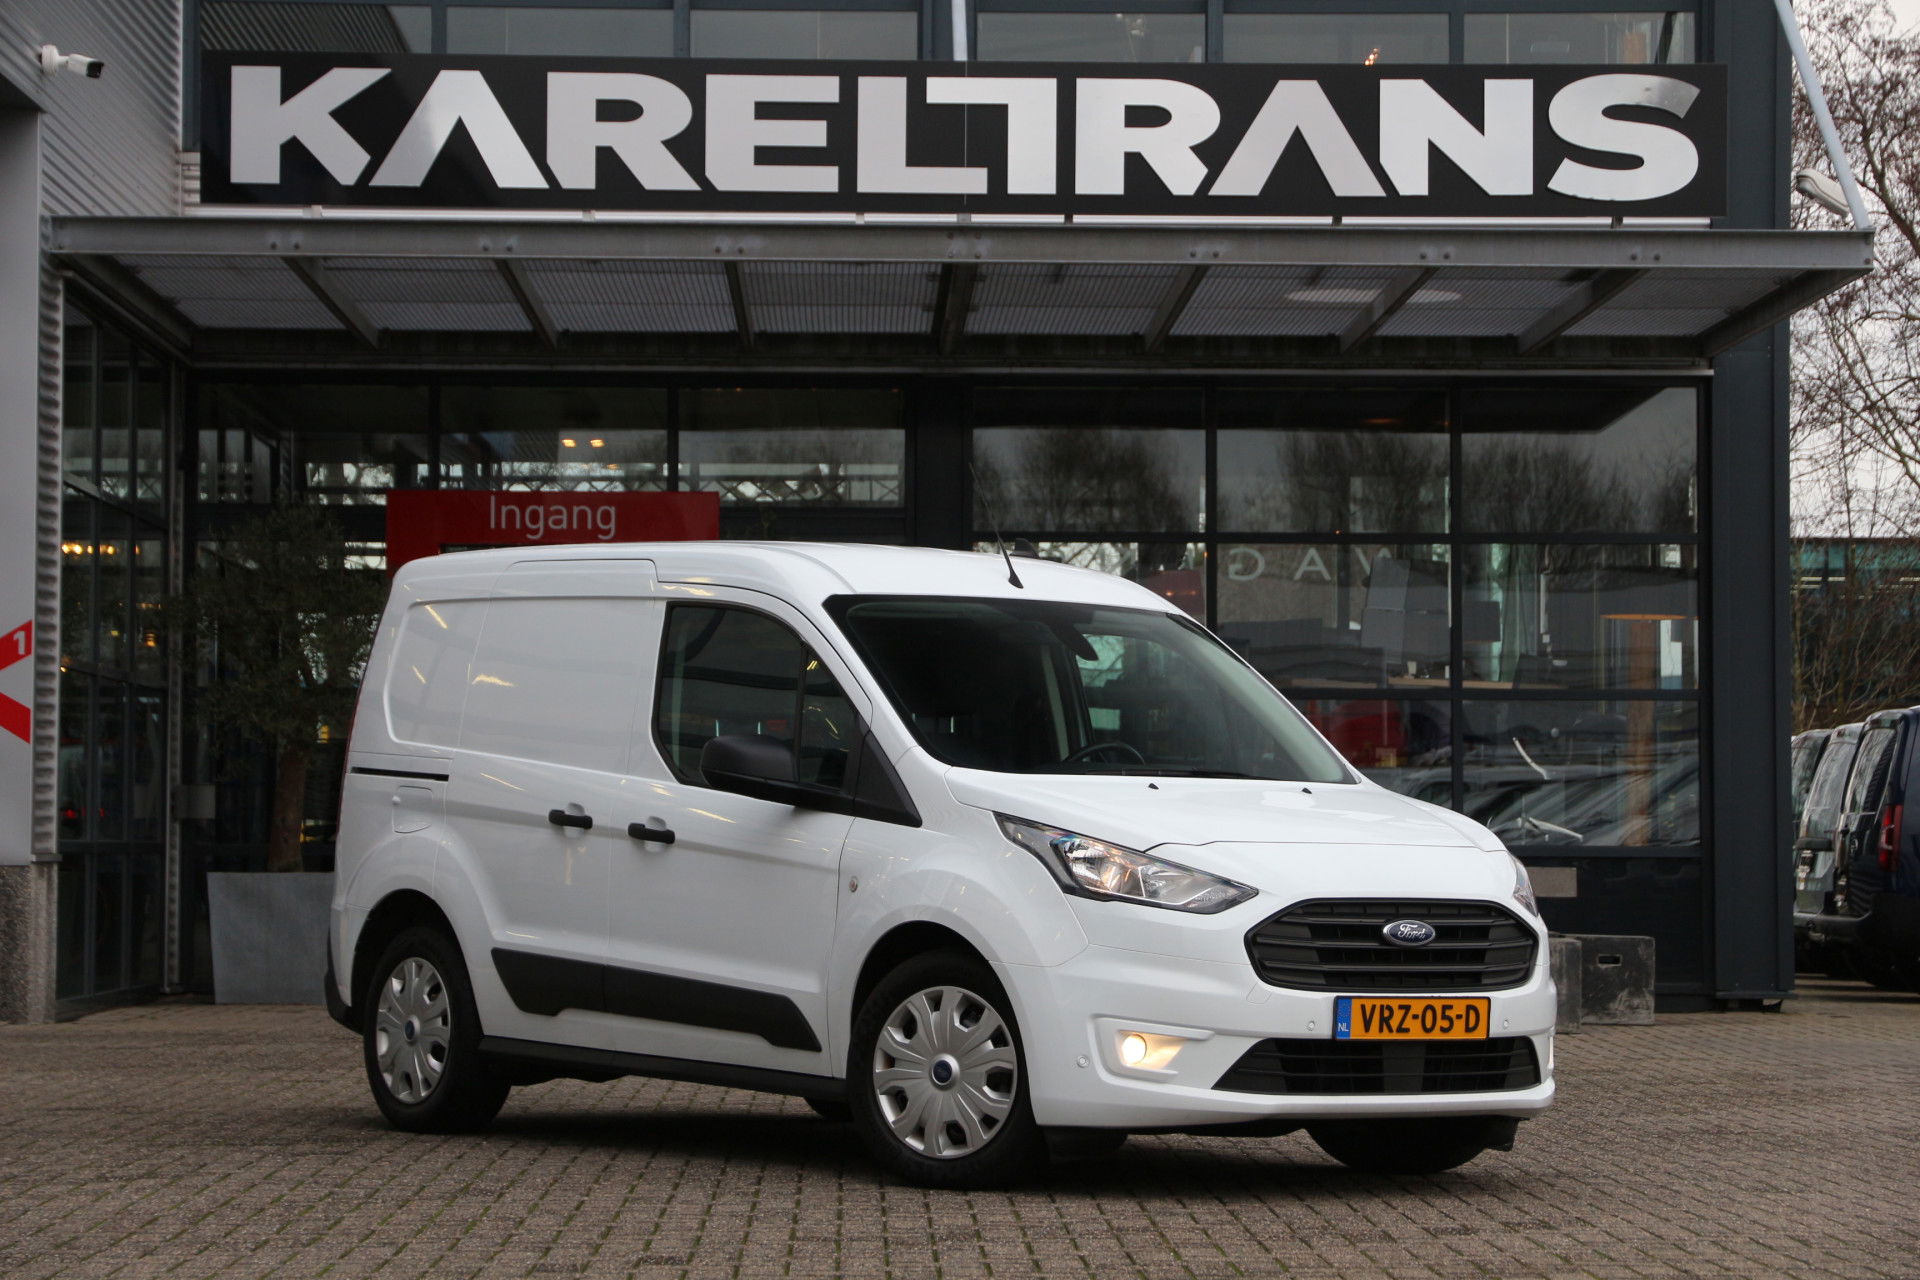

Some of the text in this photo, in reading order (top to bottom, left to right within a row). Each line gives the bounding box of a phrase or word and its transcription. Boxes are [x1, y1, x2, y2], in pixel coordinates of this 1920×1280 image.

[229, 64, 1701, 201] KARELTRANS
[490, 495, 616, 539] Ingang
[1397, 923, 1426, 938] Ford
[1337, 1004, 1480, 1033] NL VRZ-05-D
